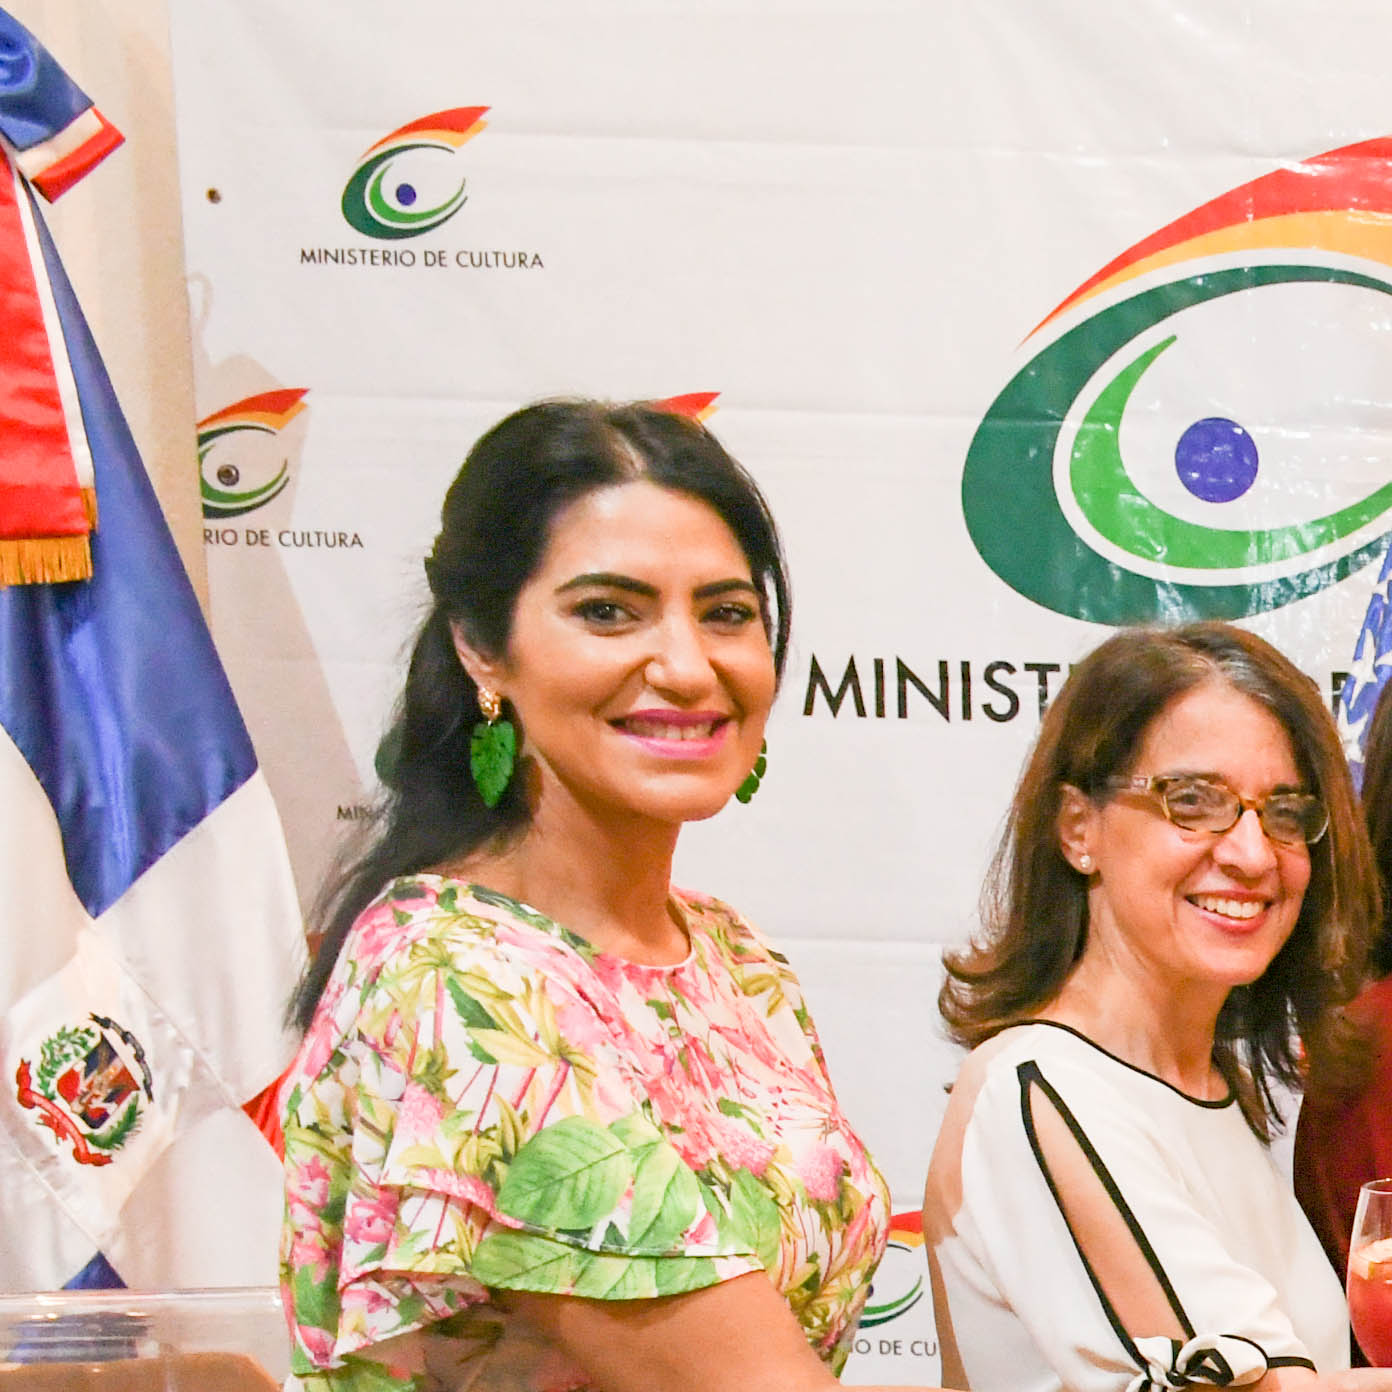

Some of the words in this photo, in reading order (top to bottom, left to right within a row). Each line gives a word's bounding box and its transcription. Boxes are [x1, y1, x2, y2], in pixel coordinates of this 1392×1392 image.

[299, 248, 416, 267] MINISTERIO
[424, 250, 448, 267] DE
[456, 250, 545, 269] CULTURA
[246, 529, 270, 547] DE
[278, 530, 365, 548] CULTURA
[803, 652, 1063, 724] MINIST
[879, 1339, 903, 1356] DE
